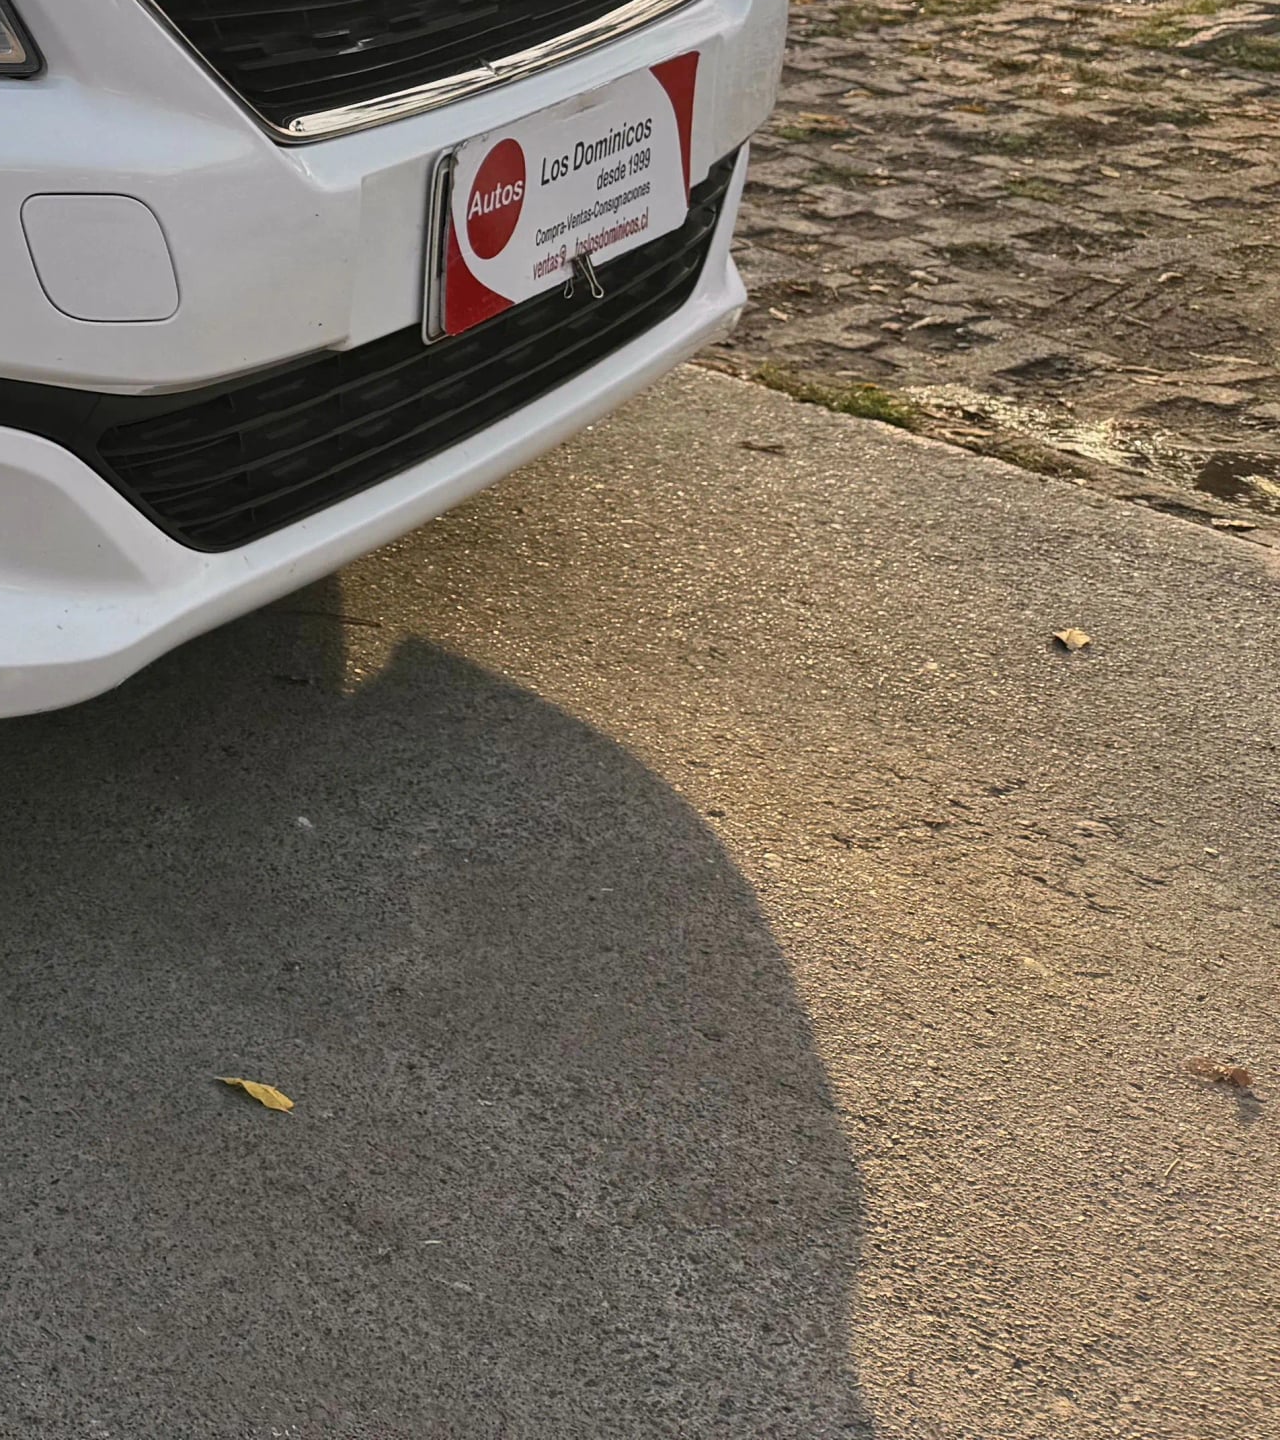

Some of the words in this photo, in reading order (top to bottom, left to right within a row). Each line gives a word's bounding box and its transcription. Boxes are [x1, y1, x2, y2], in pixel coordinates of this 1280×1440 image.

[541, 154, 569, 186] Los
[573, 117, 653, 171] Dominicos
[596, 165, 626, 191] desde
[628, 147, 652, 176] 1999
[468, 180, 523, 220] Autos
[535, 181, 651, 247] Compra-Ventas-Consignaciones
[533, 206, 650, 280] ventas@toslosdominicos.cl
